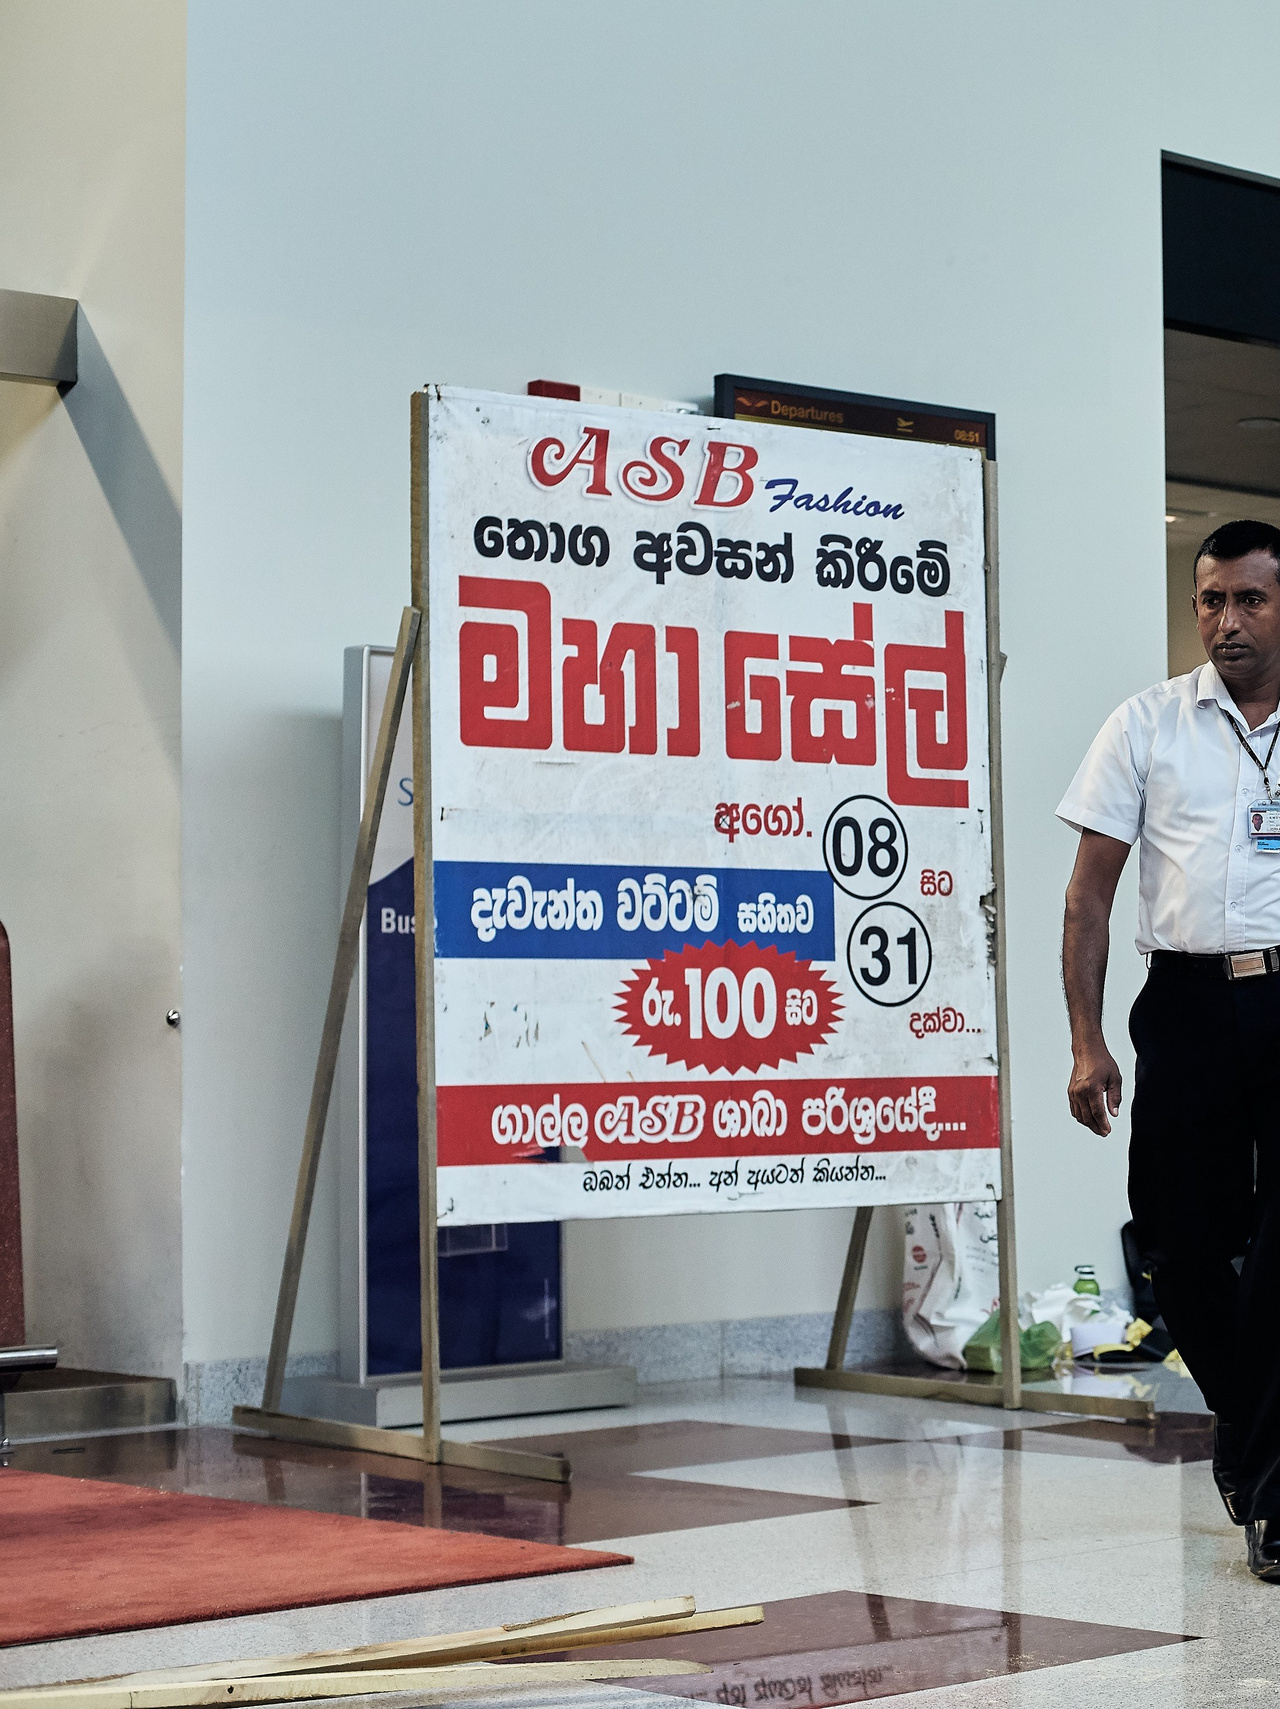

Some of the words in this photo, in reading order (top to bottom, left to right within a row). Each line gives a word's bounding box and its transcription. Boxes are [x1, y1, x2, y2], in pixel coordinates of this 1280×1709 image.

[770, 399, 844, 424] Departures
[532, 427, 758, 507] ASB
[764, 478, 905, 520] Fashion
[473, 515, 610, 568] තොග
[633, 521, 795, 586] අවසන්
[459, 576, 700, 757] මහා
[723, 602, 969, 808] සේල්
[715, 798, 811, 842] අගෝ.
[831, 816, 900, 879] 08
[920, 868, 953, 897] සිට
[470, 875, 604, 942] දැවැන්ත
[737, 892, 814, 934] සහිතව
[859, 925, 918, 987] 31
[642, 977, 682, 1027] රු.
[684, 966, 777, 1040] 100
[784, 988, 818, 1026] සිට
[491, 1093, 589, 1149] ගාල්ල
[594, 1094, 707, 1145] ASB
[583, 1163, 631, 1192] ඔබත්
[638, 1162, 701, 1190] එන්න...
[708, 1159, 739, 1192] අන්
[746, 1157, 805, 1191] අයටත්
